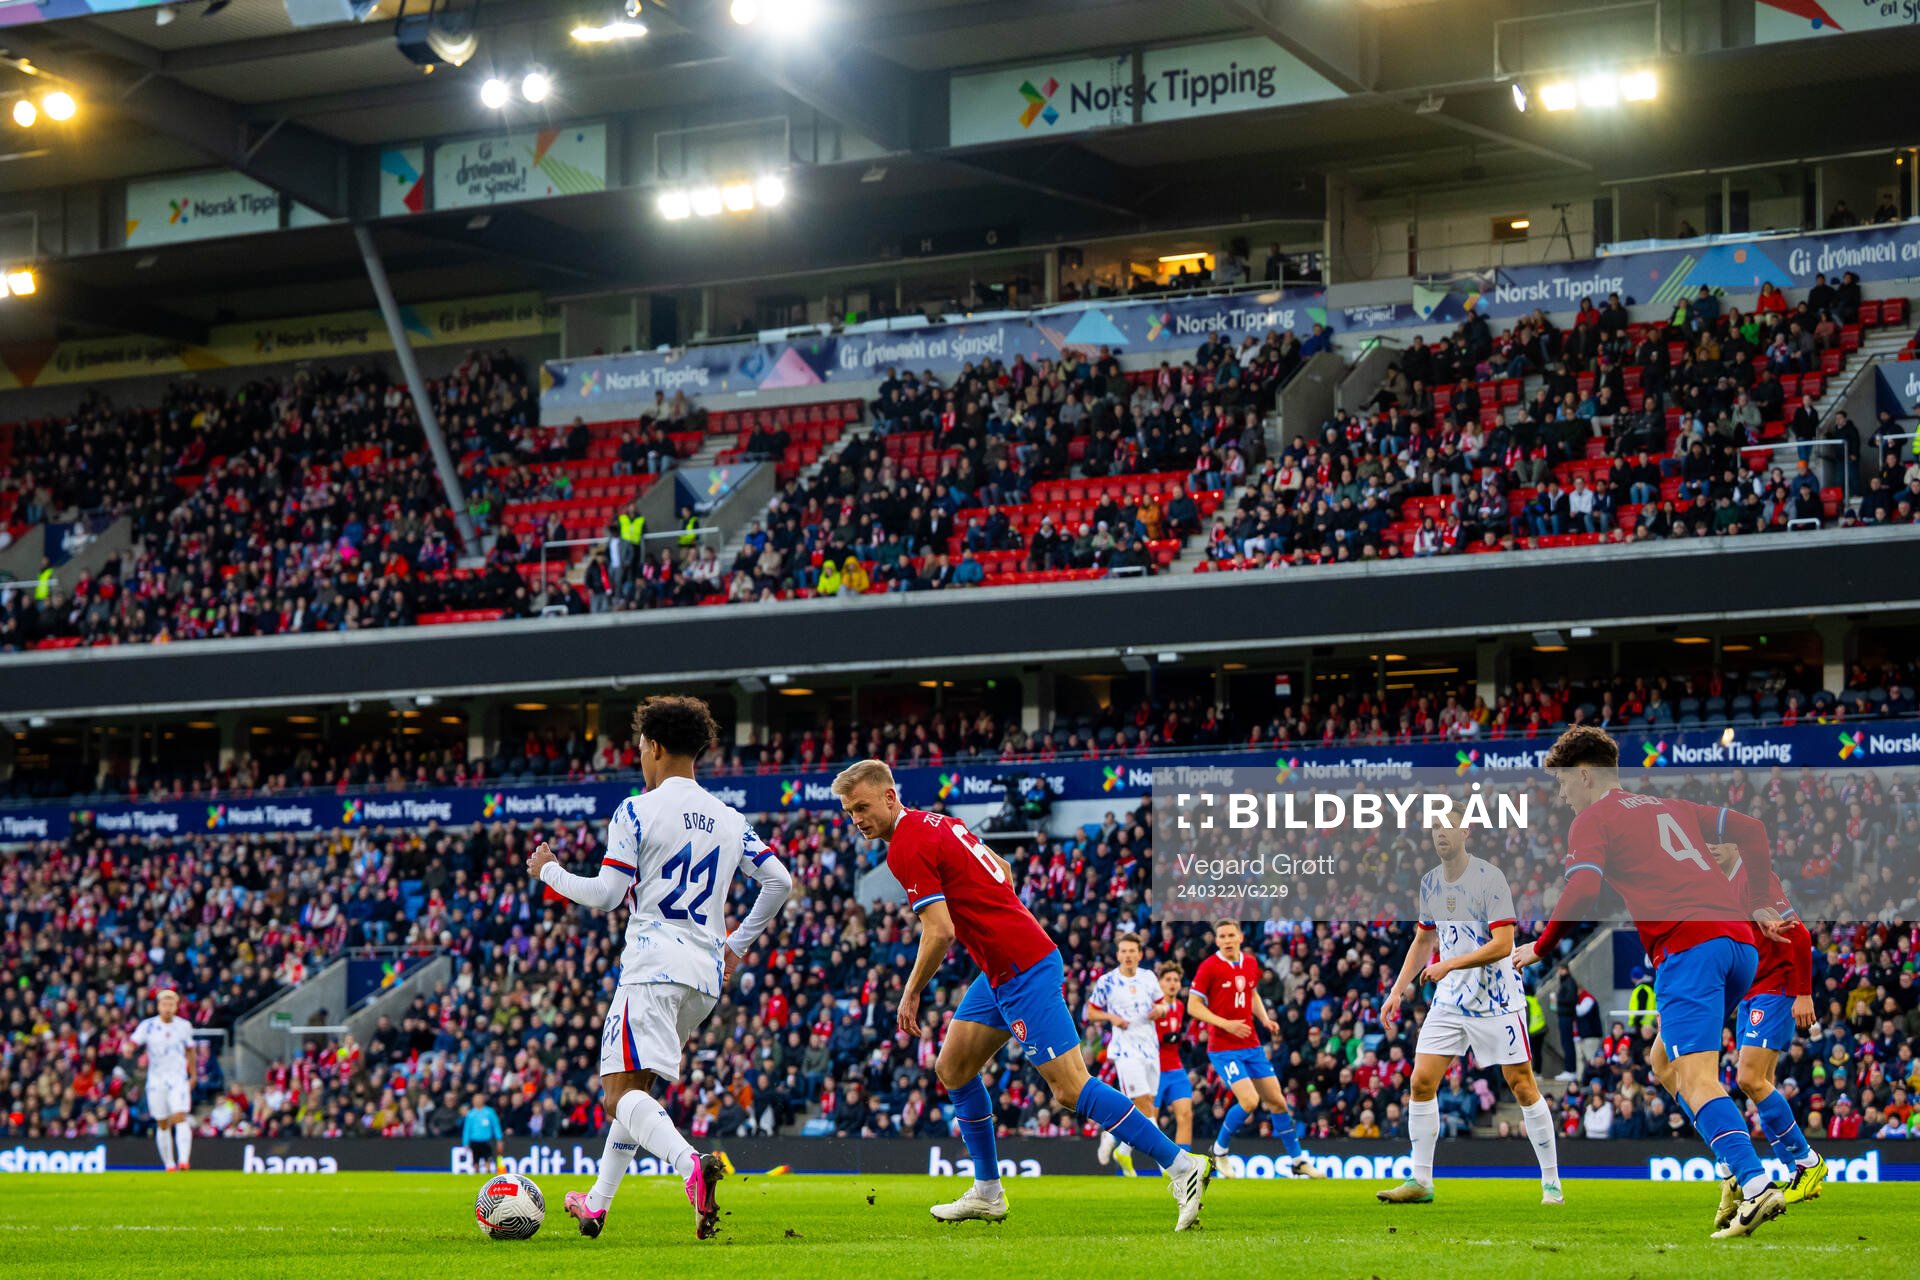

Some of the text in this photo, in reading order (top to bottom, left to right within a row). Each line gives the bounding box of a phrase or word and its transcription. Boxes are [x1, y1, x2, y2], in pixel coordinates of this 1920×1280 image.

[1071, 62, 1276, 114] Norsk Tipping
[194, 197, 237, 218] Norsk
[1789, 247, 1811, 276] Gi
[1817, 241, 1896, 273] drømmen
[1495, 274, 1624, 304] Norsk Tipping
[1176, 307, 1295, 335] Norsk Tipping
[839, 343, 859, 369] Gi
[951, 327, 1005, 362] sjanse!
[605, 364, 710, 391] Norsk Tipping
[1672, 740, 1792, 765] Norsk Tipping
[1870, 732, 1920, 755] Norsk
[1303, 757, 1413, 781] Norsk Tipping
[1483, 750, 1534, 771] Norsk
[1128, 765, 1235, 787] Norsk Tipping
[228, 804, 312, 826] Norsk Tipping
[364, 799, 451, 821] Norsk Tipping
[505, 794, 596, 816] Norsk Tipping
[3, 816, 48, 838] Tipping
[96, 810, 178, 832] Norsk Tipping
[683, 812, 715, 834] BOBB
[1656, 813, 1711, 871] 4
[951, 824, 1006, 884] 6
[658, 841, 721, 926] 22
[1449, 925, 1459, 945] 3
[1234, 992, 1246, 1009] 14
[1505, 1025, 1516, 1047] 3
[1223, 1060, 1240, 1080] 14
[451, 1146, 566, 1175] Bndit
